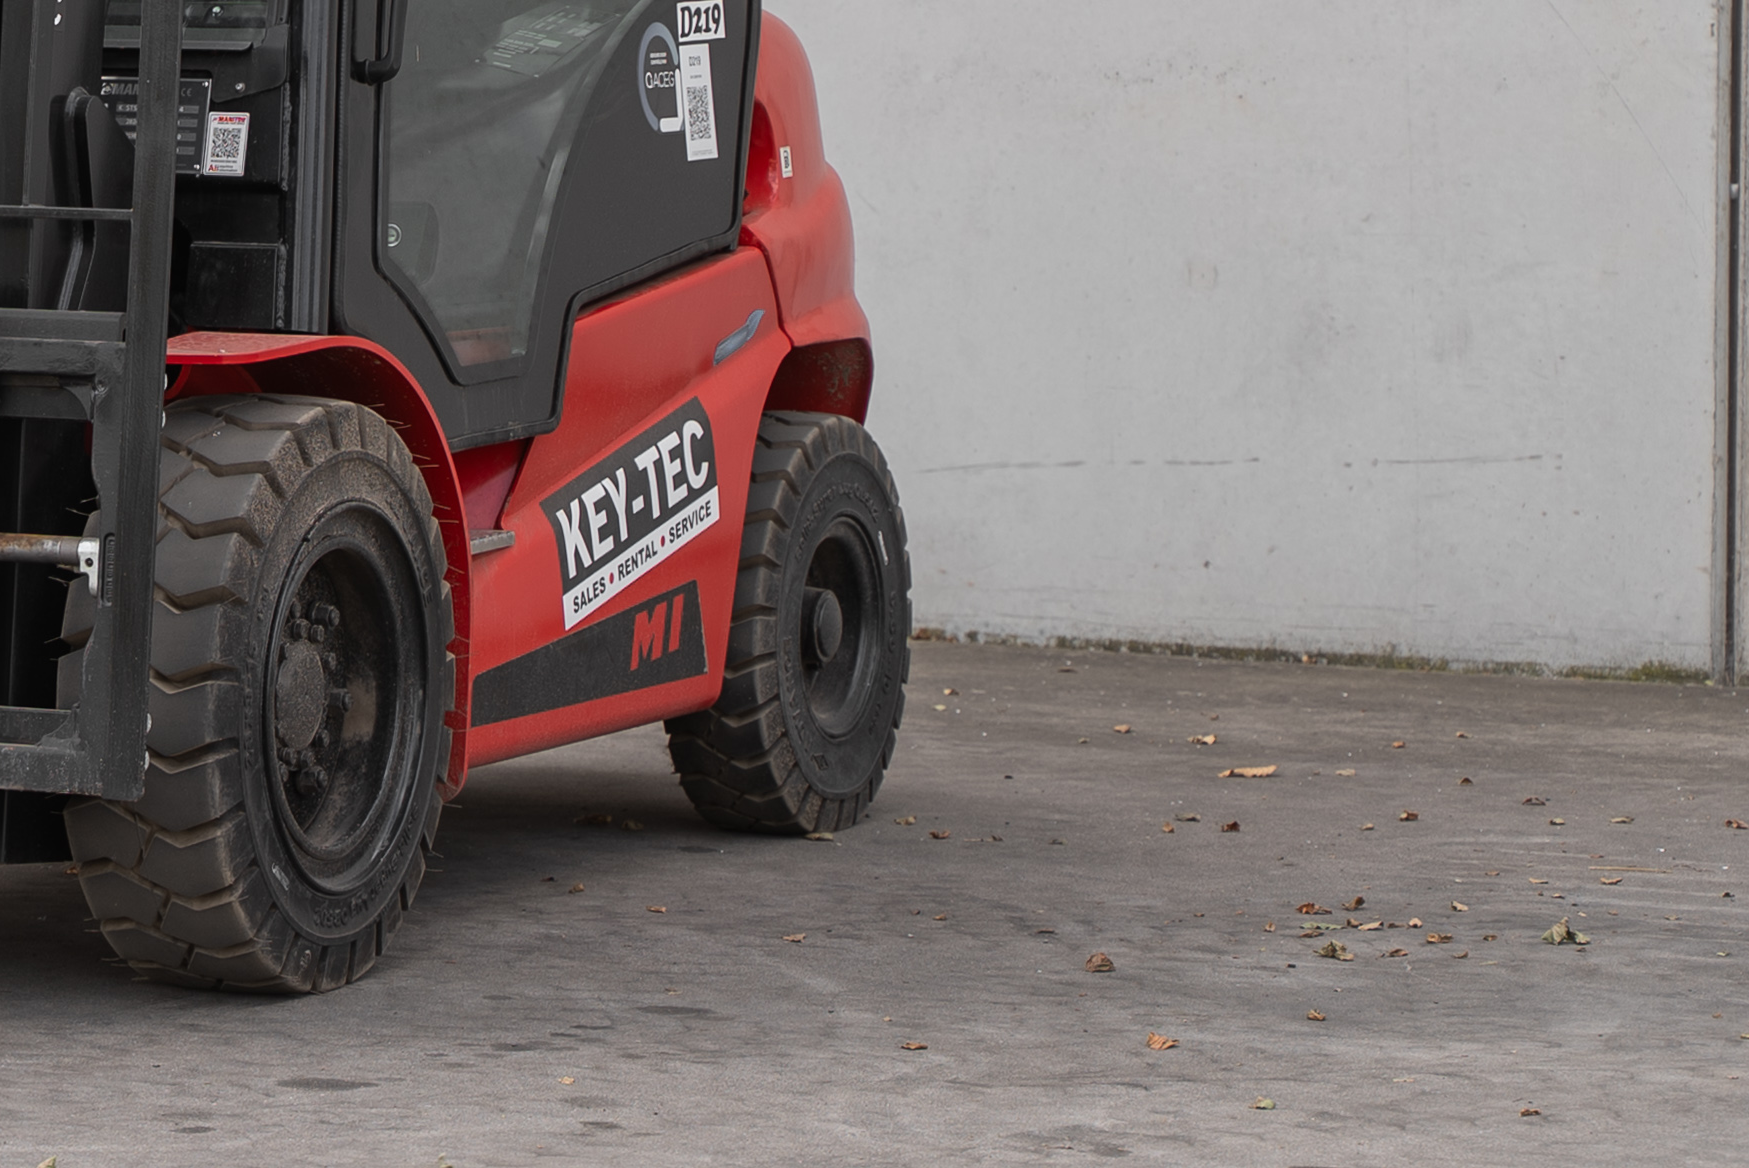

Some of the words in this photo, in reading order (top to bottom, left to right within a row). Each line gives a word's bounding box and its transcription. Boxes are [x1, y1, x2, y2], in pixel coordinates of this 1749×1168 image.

[679, 3, 721, 38] D219
[555, 419, 709, 580] KEY-TEC
[572, 576, 607, 614] SALES
[617, 540, 659, 582] RENTAL
[668, 499, 712, 544] SERVICE
[629, 593, 685, 672] MI
